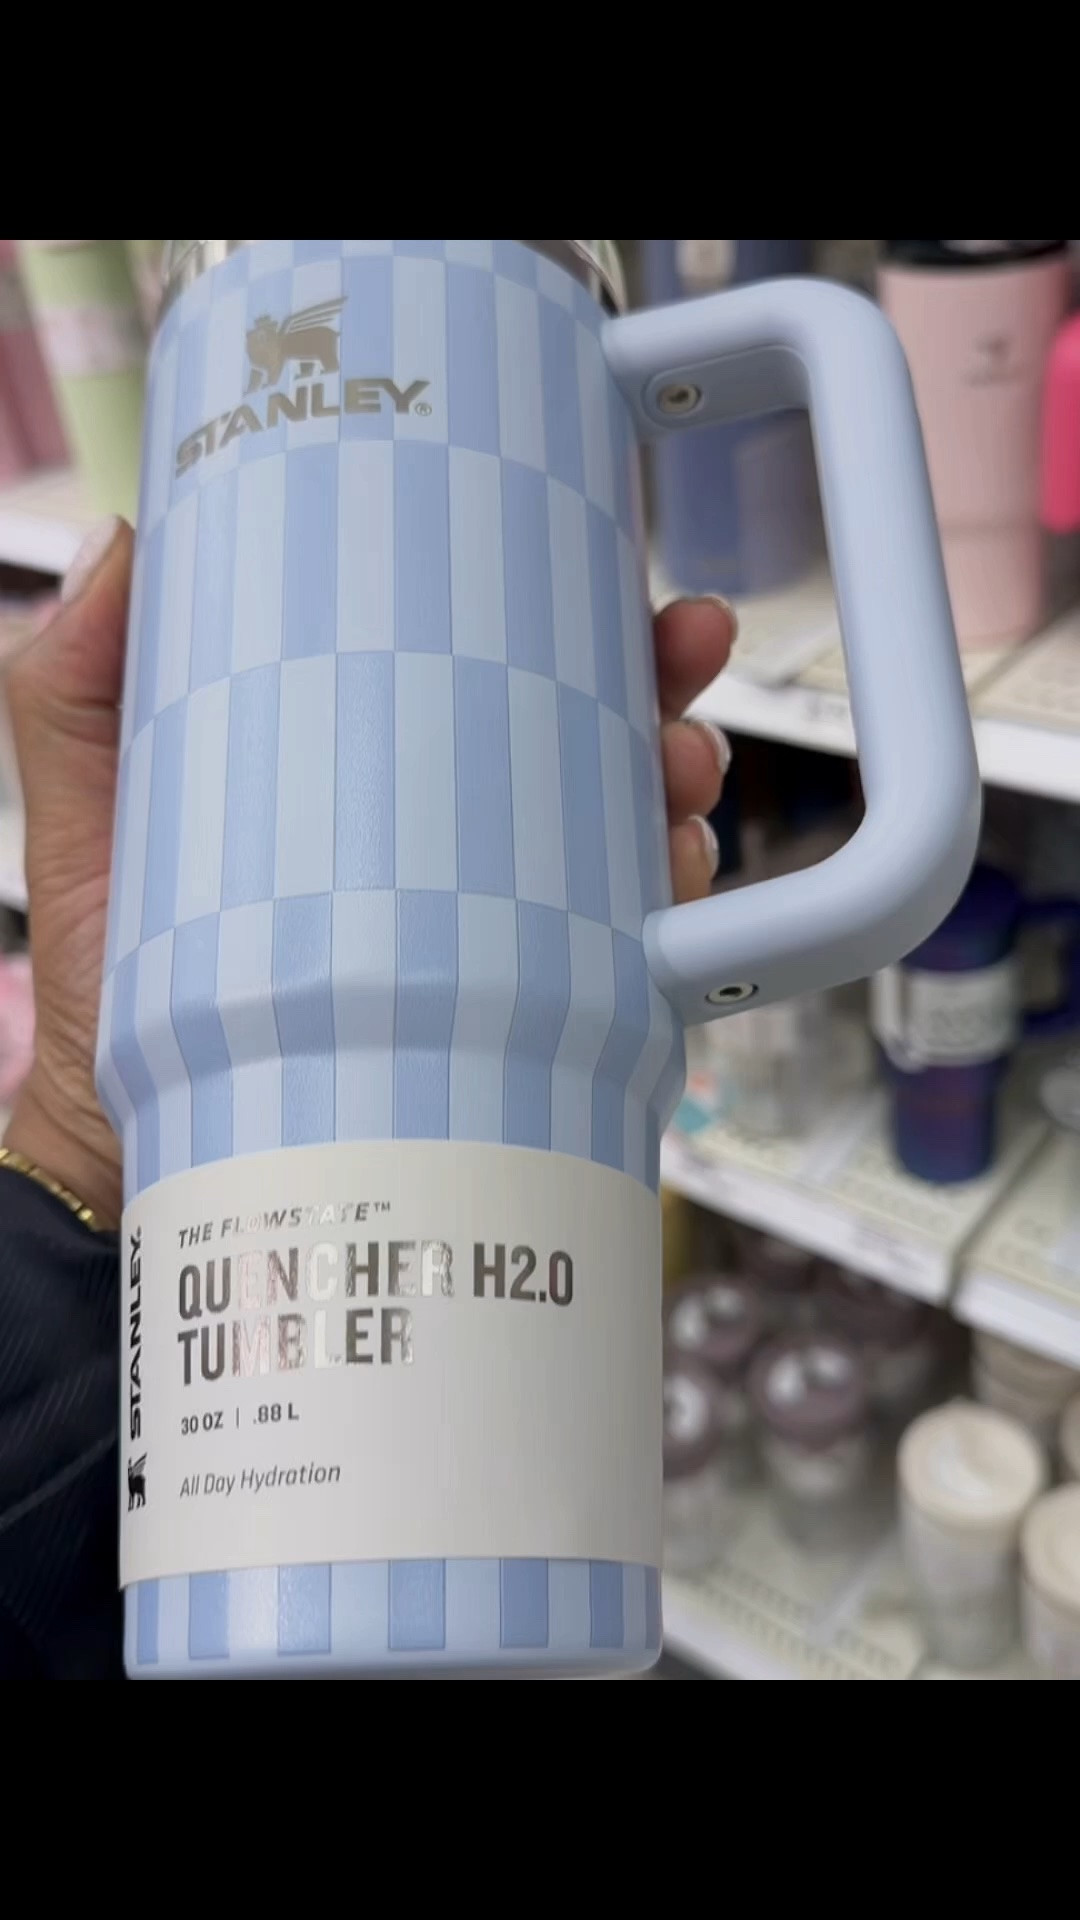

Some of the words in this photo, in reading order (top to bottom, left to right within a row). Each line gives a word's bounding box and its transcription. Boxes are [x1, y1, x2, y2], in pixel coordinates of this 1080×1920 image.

[178, 1221, 213, 1249] THE
[178, 1240, 456, 1320] QUENCHER
[473, 1242, 575, 1306] H2.0
[177, 1307, 415, 1386] TUMBLER
[180, 1415, 199, 1435] 30
[202, 1412, 225, 1431] OZ
[252, 1404, 283, 1424] .88
[288, 1402, 300, 1421] L
[180, 1474, 201, 1498] All
[204, 1470, 237, 1501] Day
[240, 1460, 342, 1494] Hydration
